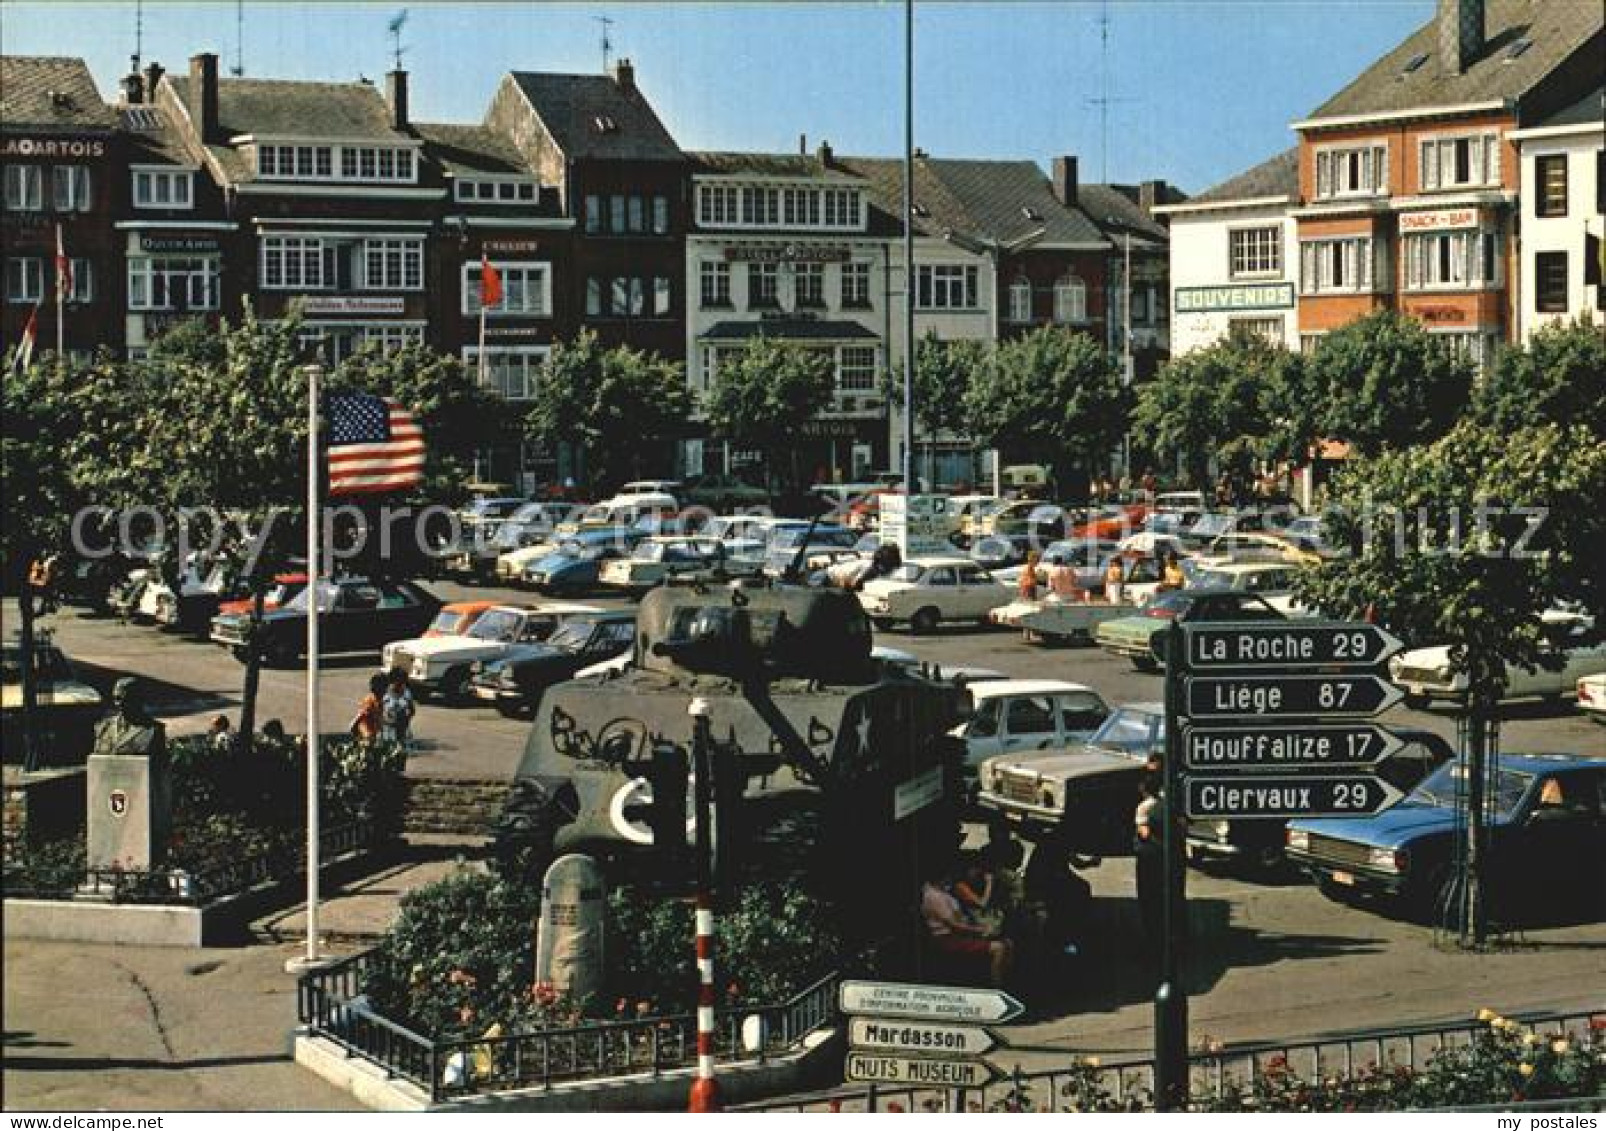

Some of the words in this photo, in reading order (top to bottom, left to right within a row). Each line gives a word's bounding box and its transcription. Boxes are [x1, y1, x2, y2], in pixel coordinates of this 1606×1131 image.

[34, 141, 104, 157] ARTOIS
[1178, 286, 1289, 308] SOUVENIRS
[1199, 634, 1226, 660] La
[1238, 634, 1313, 660] Roche
[1332, 632, 1367, 658] 29
[1318, 683, 1352, 708] 87
[1192, 733, 1331, 761] Houffalize
[1346, 733, 1373, 757] 17
[1201, 785, 1311, 811] Clervaux
[1332, 784, 1368, 809] 29
[865, 1025, 966, 1049] Mardasson
[908, 1062, 975, 1084] MUSEUM
